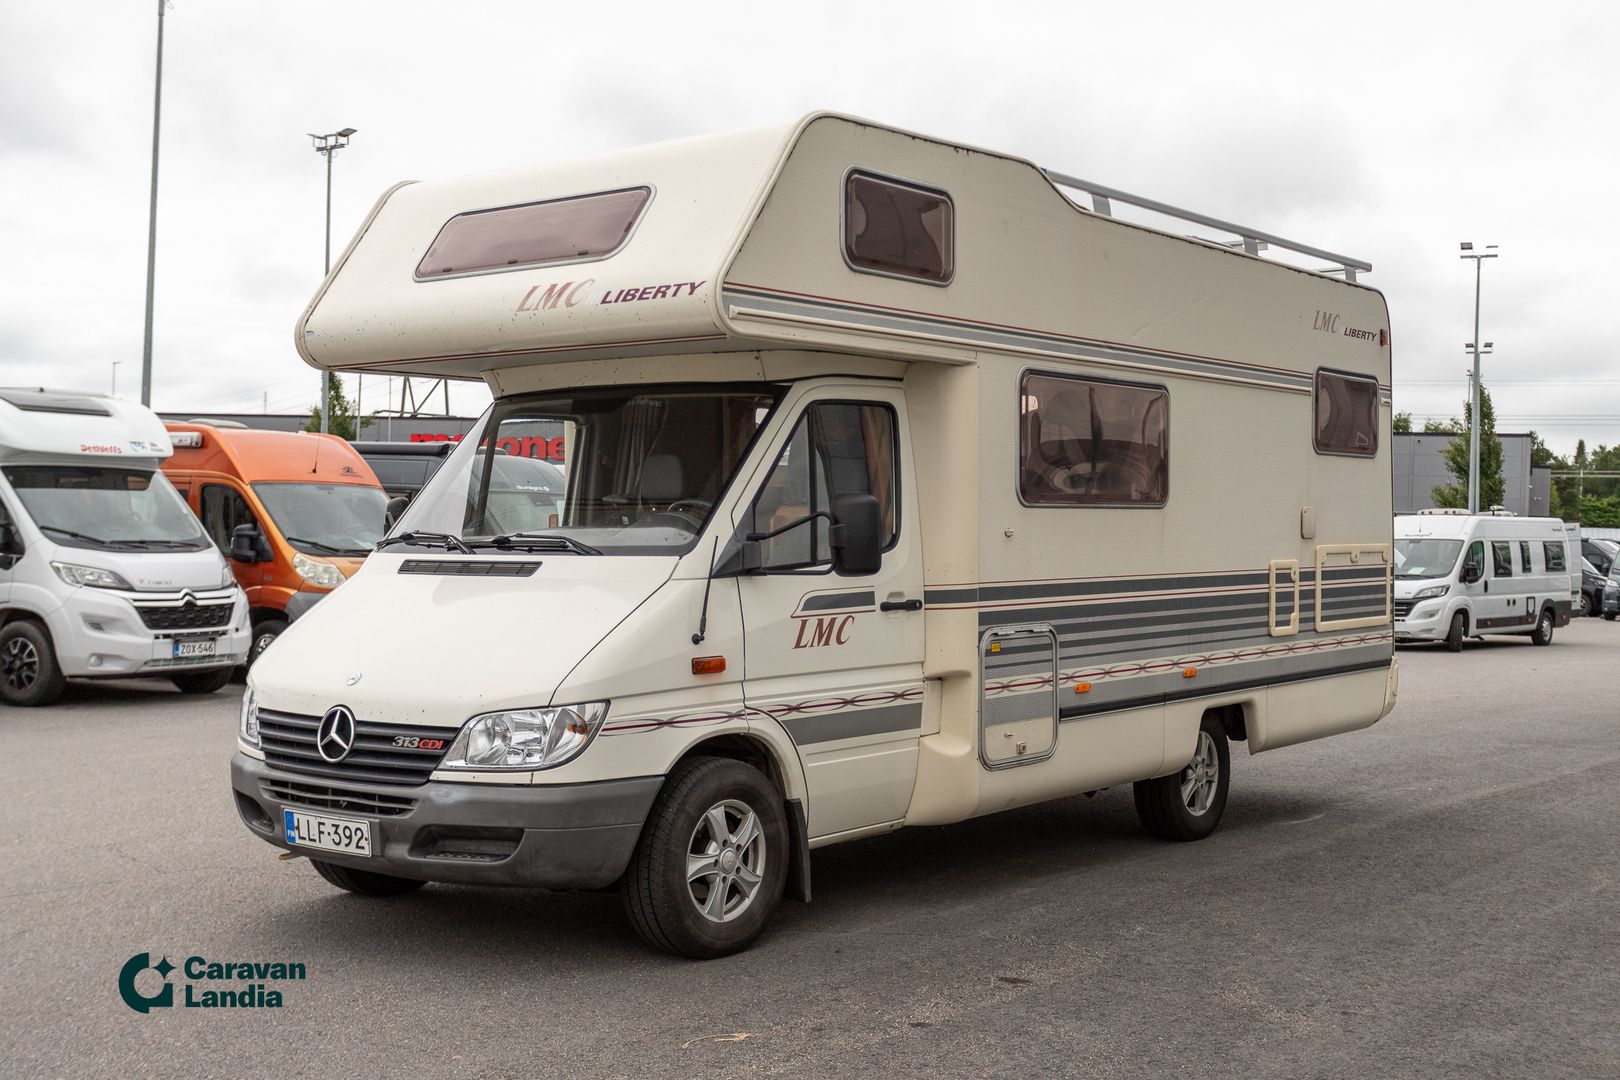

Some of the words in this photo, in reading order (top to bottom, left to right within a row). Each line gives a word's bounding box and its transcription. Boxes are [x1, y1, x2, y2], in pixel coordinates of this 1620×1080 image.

[515, 278, 596, 312] LMC
[600, 280, 707, 305] LIBERTY
[1312, 309, 1341, 333] LMC
[1343, 326, 1377, 341] LIBERTY
[792, 614, 856, 650] LMC
[180, 643, 214, 655] ZOX-546
[296, 817, 365, 849] LLF-392
